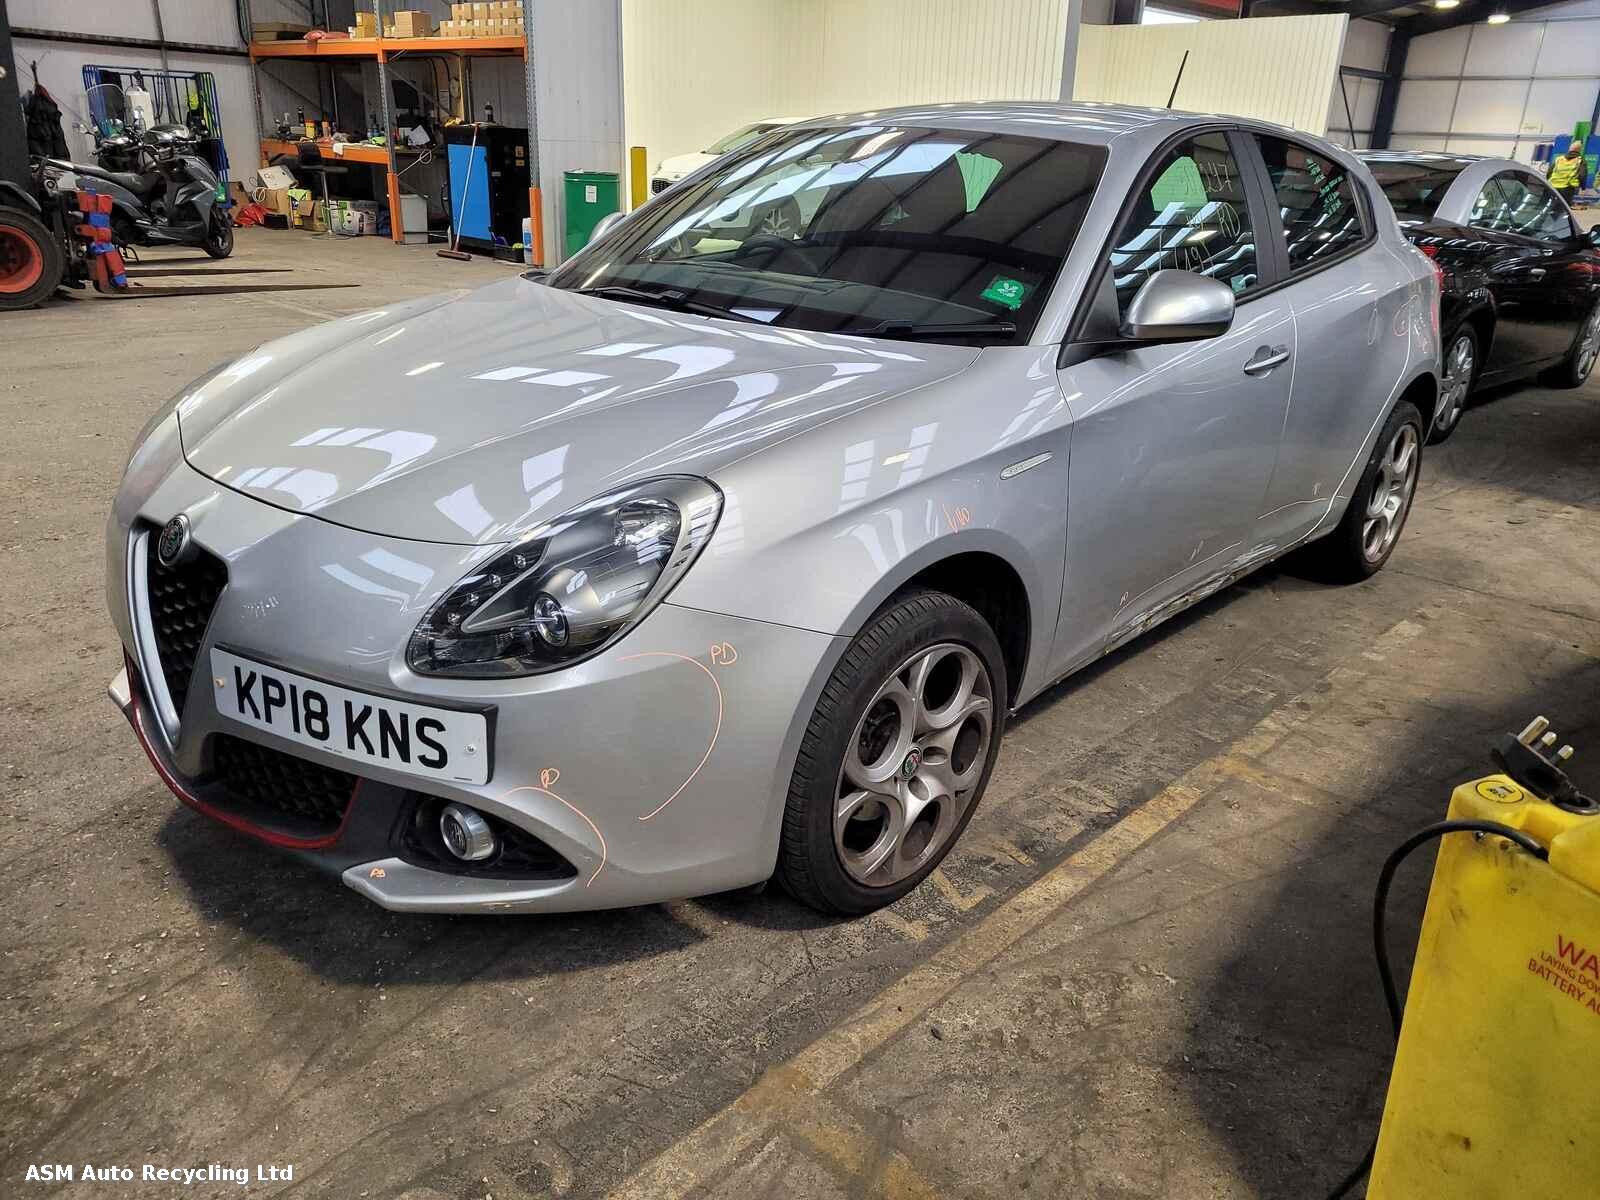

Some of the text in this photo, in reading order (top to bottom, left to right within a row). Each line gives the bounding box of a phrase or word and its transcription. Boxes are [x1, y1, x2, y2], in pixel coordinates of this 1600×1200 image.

[233, 665, 449, 770] KP18 KNS
[1528, 958, 1585, 1001] BATTERY
[1540, 951, 1576, 979] LAYING
